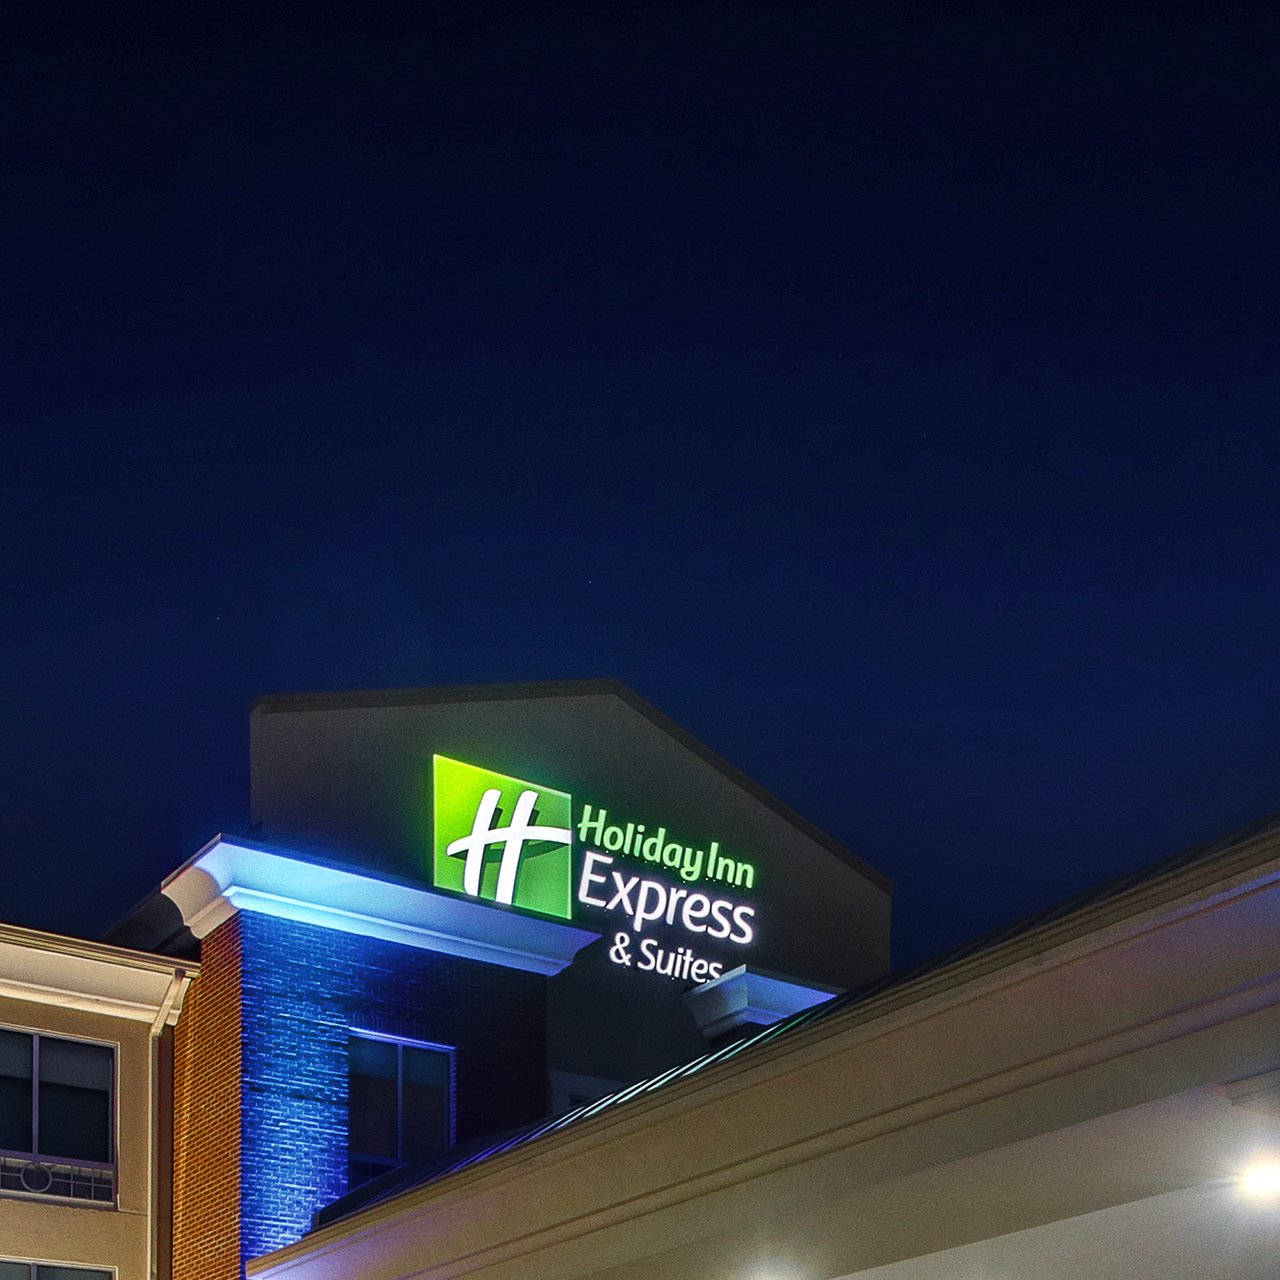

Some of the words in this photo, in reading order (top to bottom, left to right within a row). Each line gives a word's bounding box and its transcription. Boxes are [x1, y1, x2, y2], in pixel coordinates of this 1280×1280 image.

[577, 804, 704, 882] Holiday
[706, 842, 754, 889] Inn
[578, 851, 756, 945] Express
[609, 932, 632, 966] &
[637, 939, 723, 984] Suites
